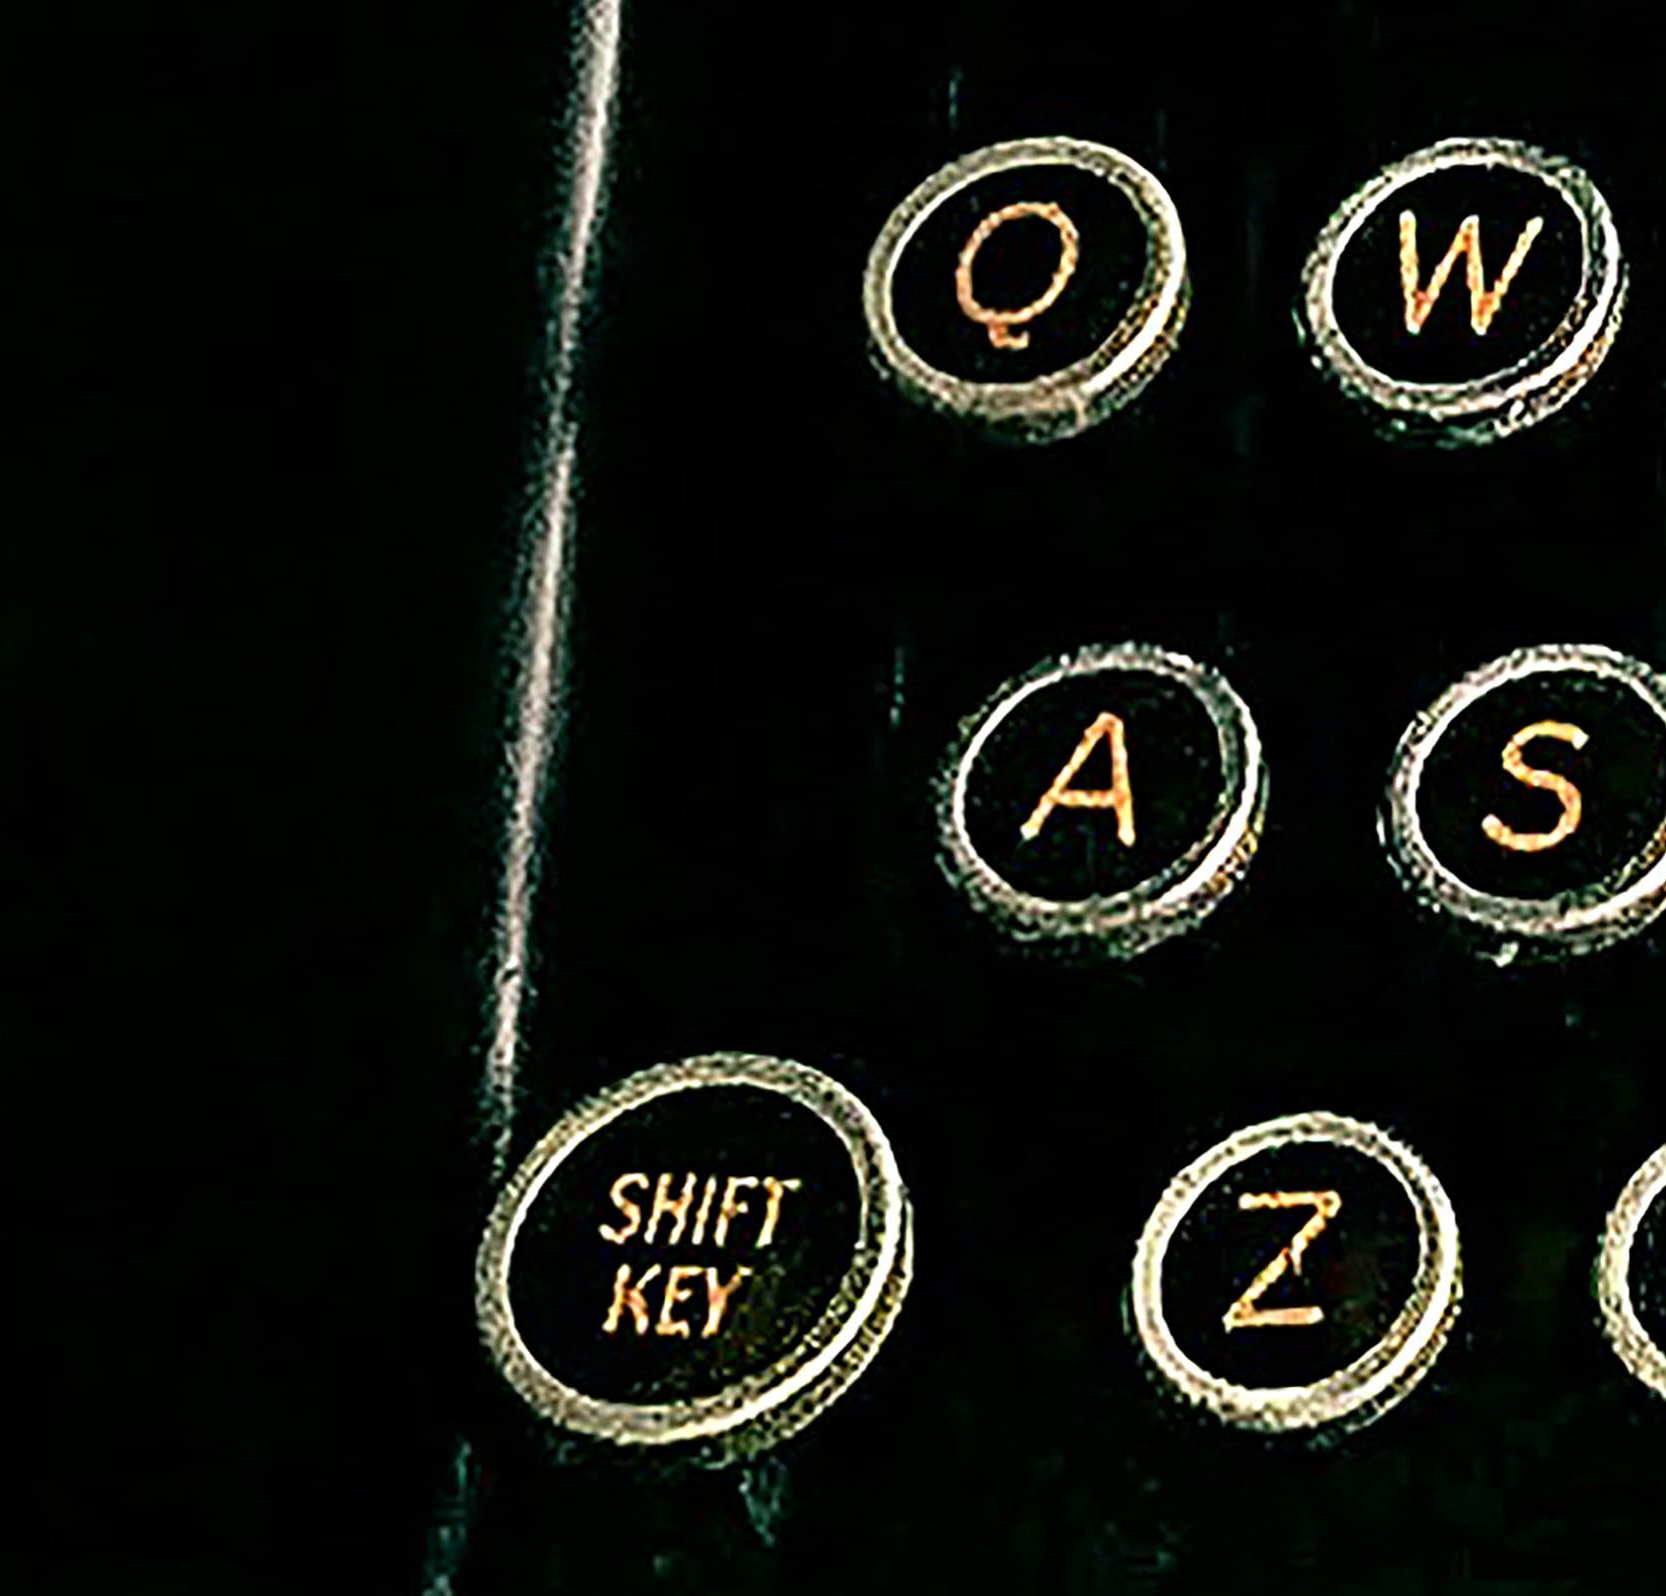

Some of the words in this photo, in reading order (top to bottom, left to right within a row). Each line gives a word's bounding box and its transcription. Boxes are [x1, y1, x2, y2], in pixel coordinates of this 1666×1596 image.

[956, 202, 1079, 349] Q
[1400, 210, 1543, 335] W
[1020, 712, 1135, 846] A
[1482, 720, 1589, 852] S
[599, 1172, 801, 1248] SHIFT
[1222, 1191, 1341, 1332] Z
[603, 1264, 751, 1338] KEY
